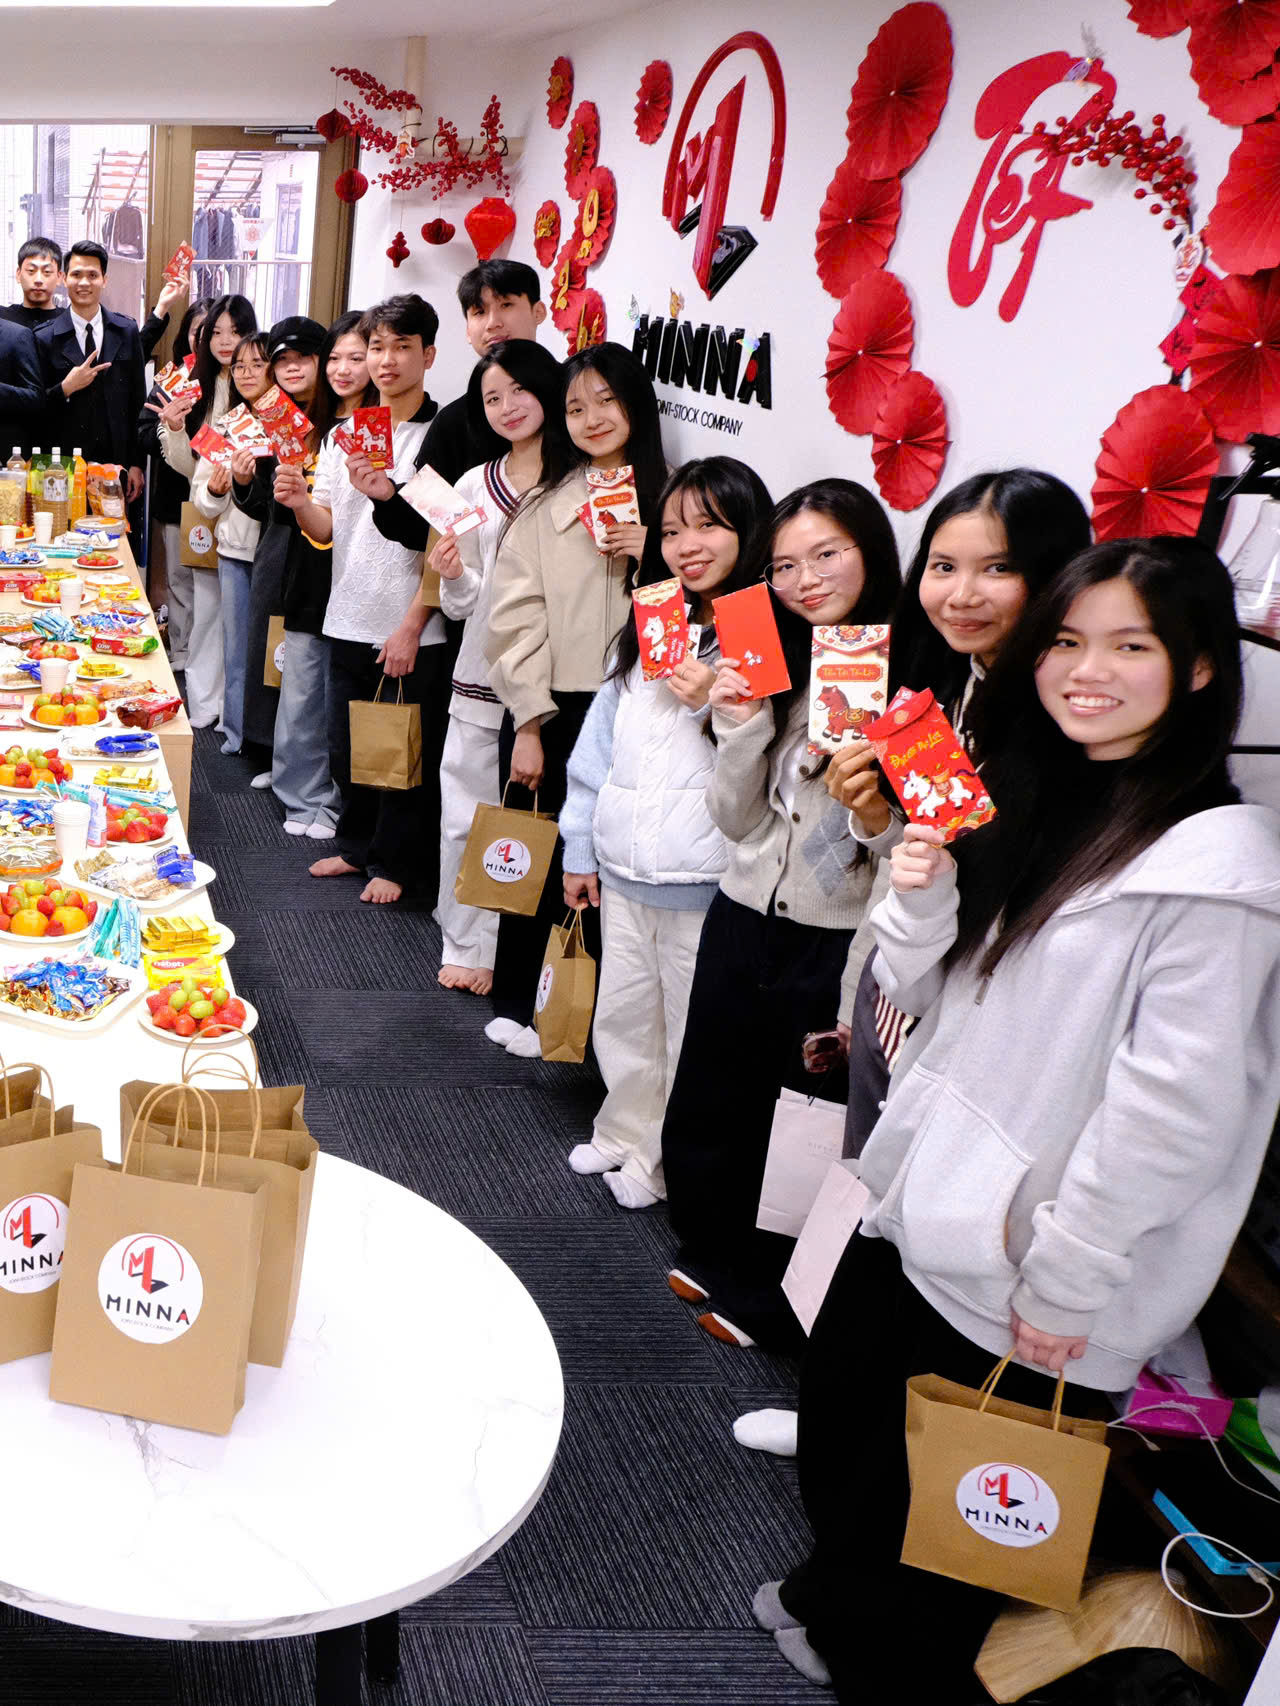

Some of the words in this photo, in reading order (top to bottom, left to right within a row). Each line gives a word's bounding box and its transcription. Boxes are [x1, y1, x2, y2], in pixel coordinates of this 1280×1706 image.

[632, 314, 772, 410] MINNA
[701, 411, 743, 436] COMPANY
[485, 863, 523, 876] MINNA
[106, 1293, 190, 1326] MINNA
[965, 1507, 1048, 1536] MINNA
